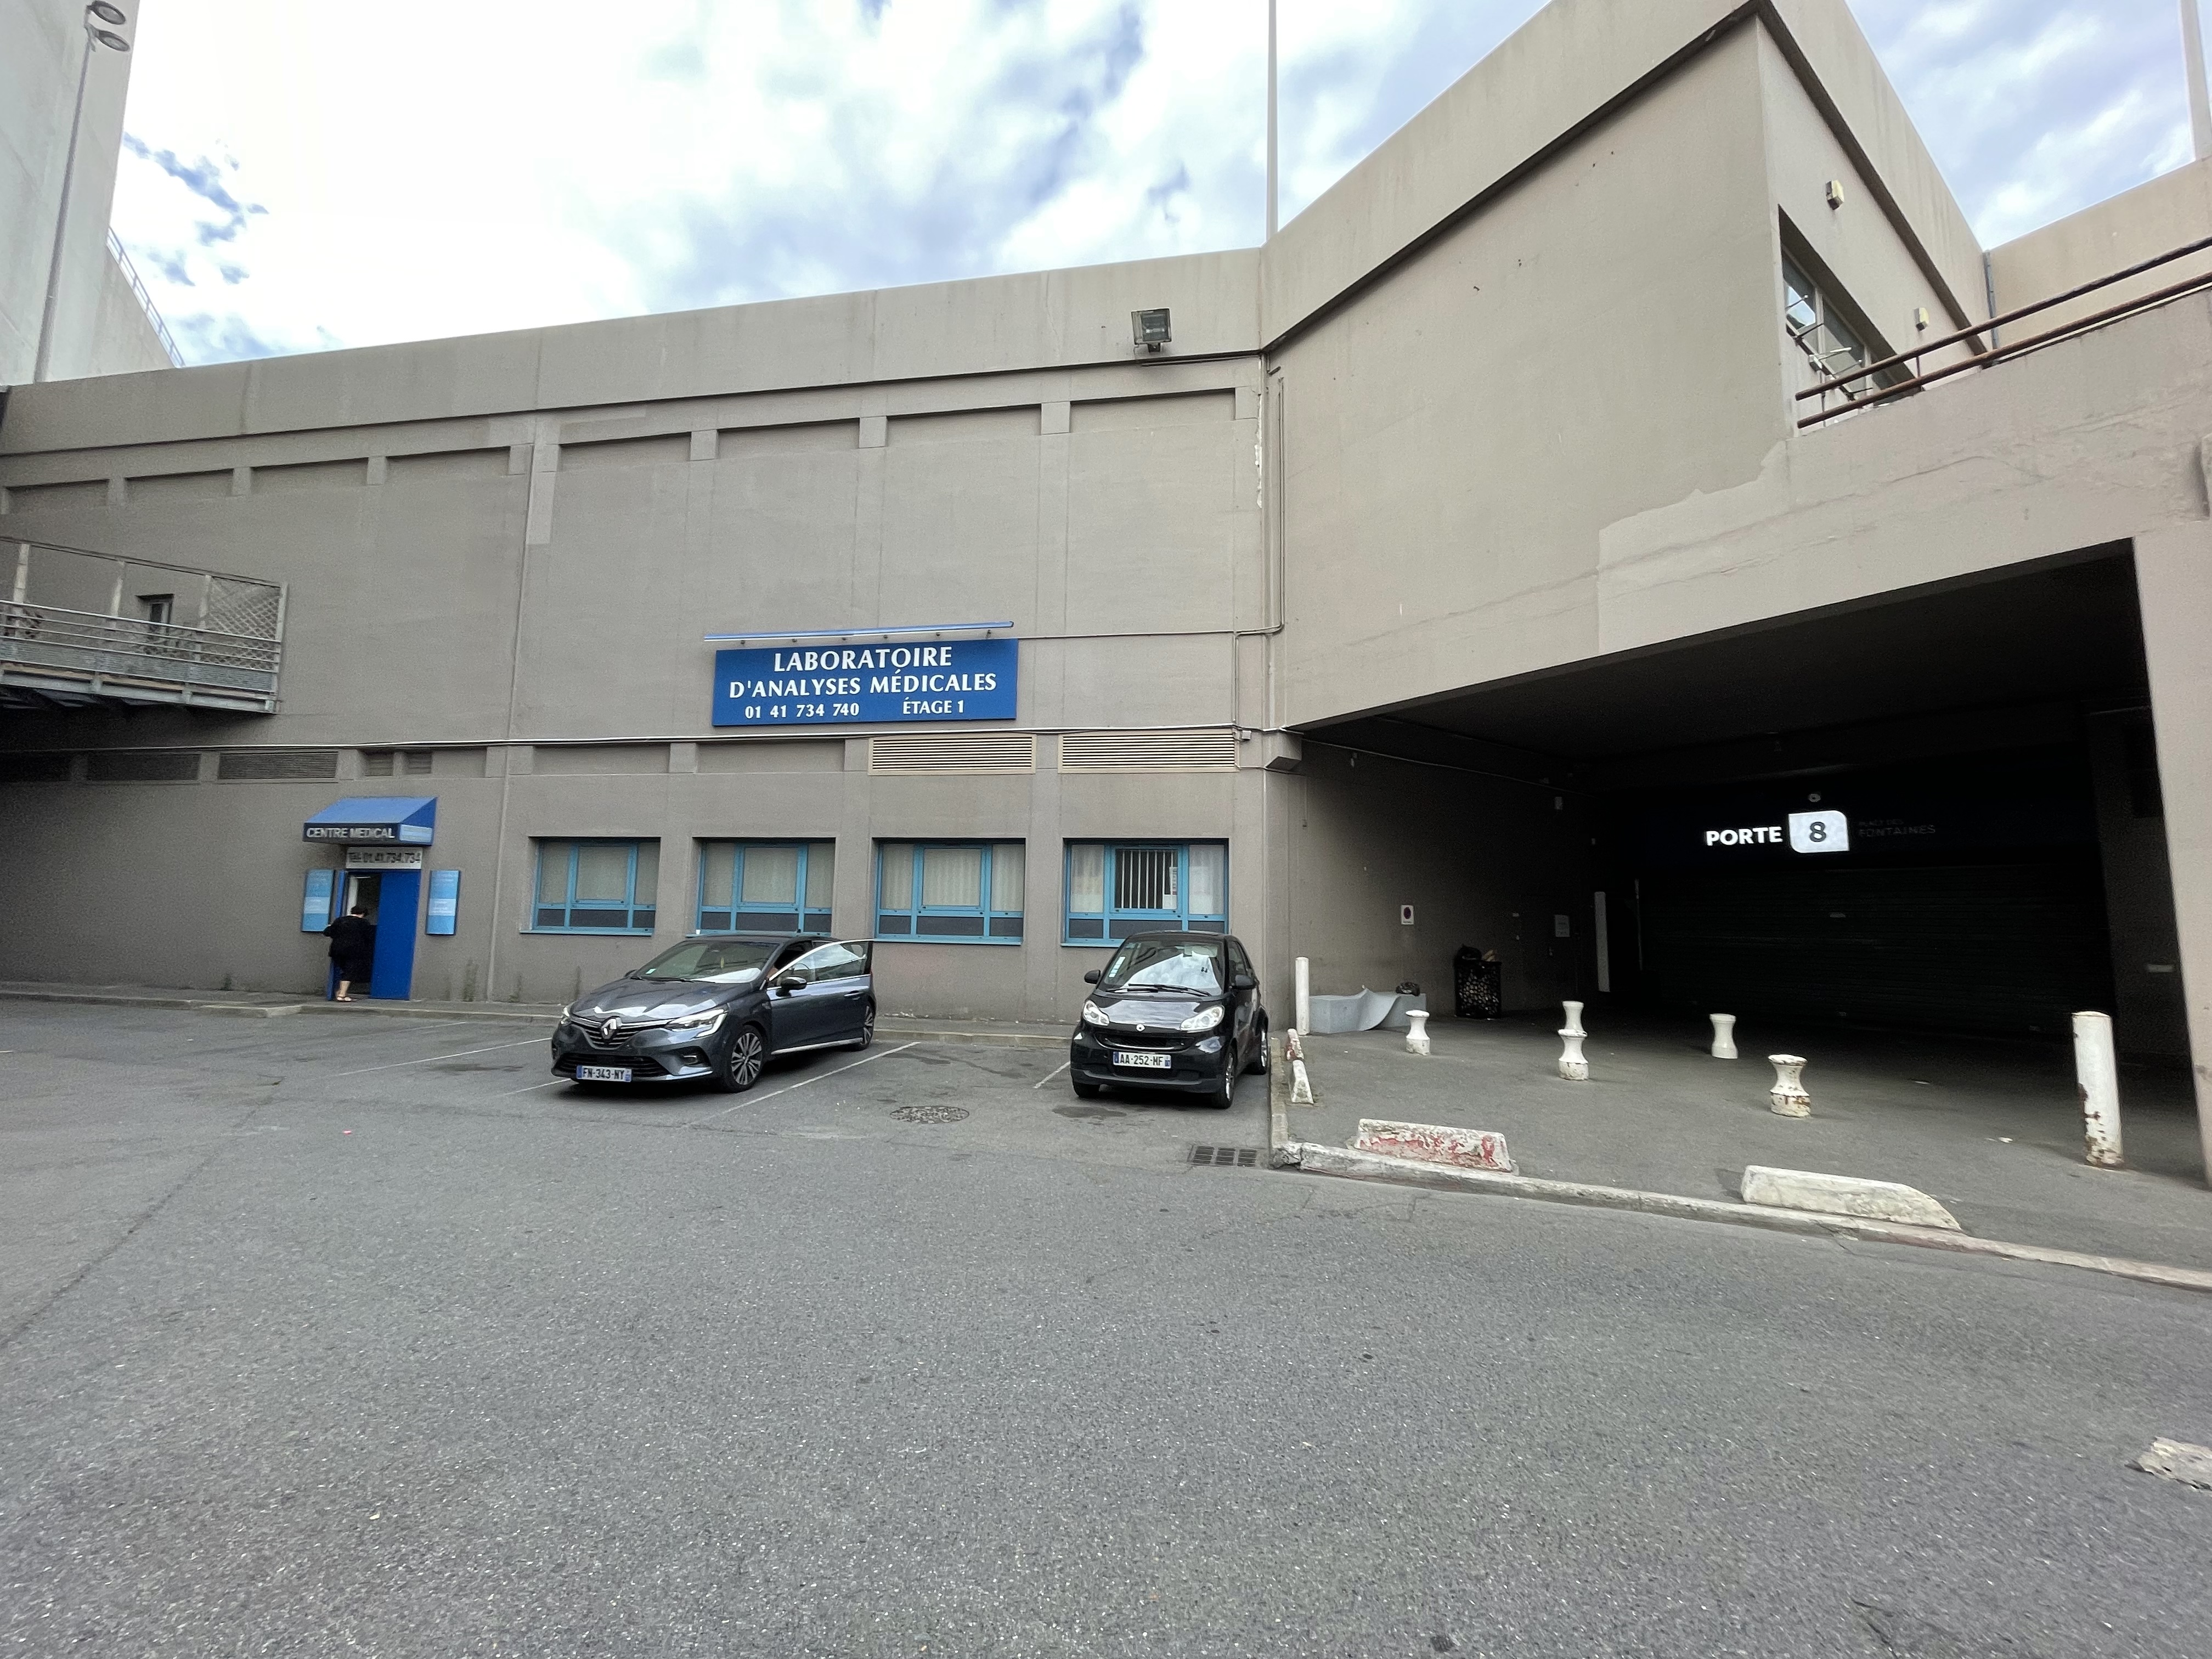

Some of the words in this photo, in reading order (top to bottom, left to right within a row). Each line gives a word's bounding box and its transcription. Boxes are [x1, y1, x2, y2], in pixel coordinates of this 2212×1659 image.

[774, 646, 952, 672] LABORATOIRE
[729, 675, 861, 698] D'ANALYSES
[870, 669, 997, 693] MÉDICALES
[745, 706, 761, 719] 01
[770, 704, 787, 718] 41
[796, 703, 825, 717] 734
[832, 702, 860, 716] 740
[902, 697, 953, 714] ÉTAGE
[957, 699, 964, 713] 1
[306, 827, 348, 838] CENTRE
[1706, 826, 1783, 846] PORTE
[1809, 821, 1827, 842] 8
